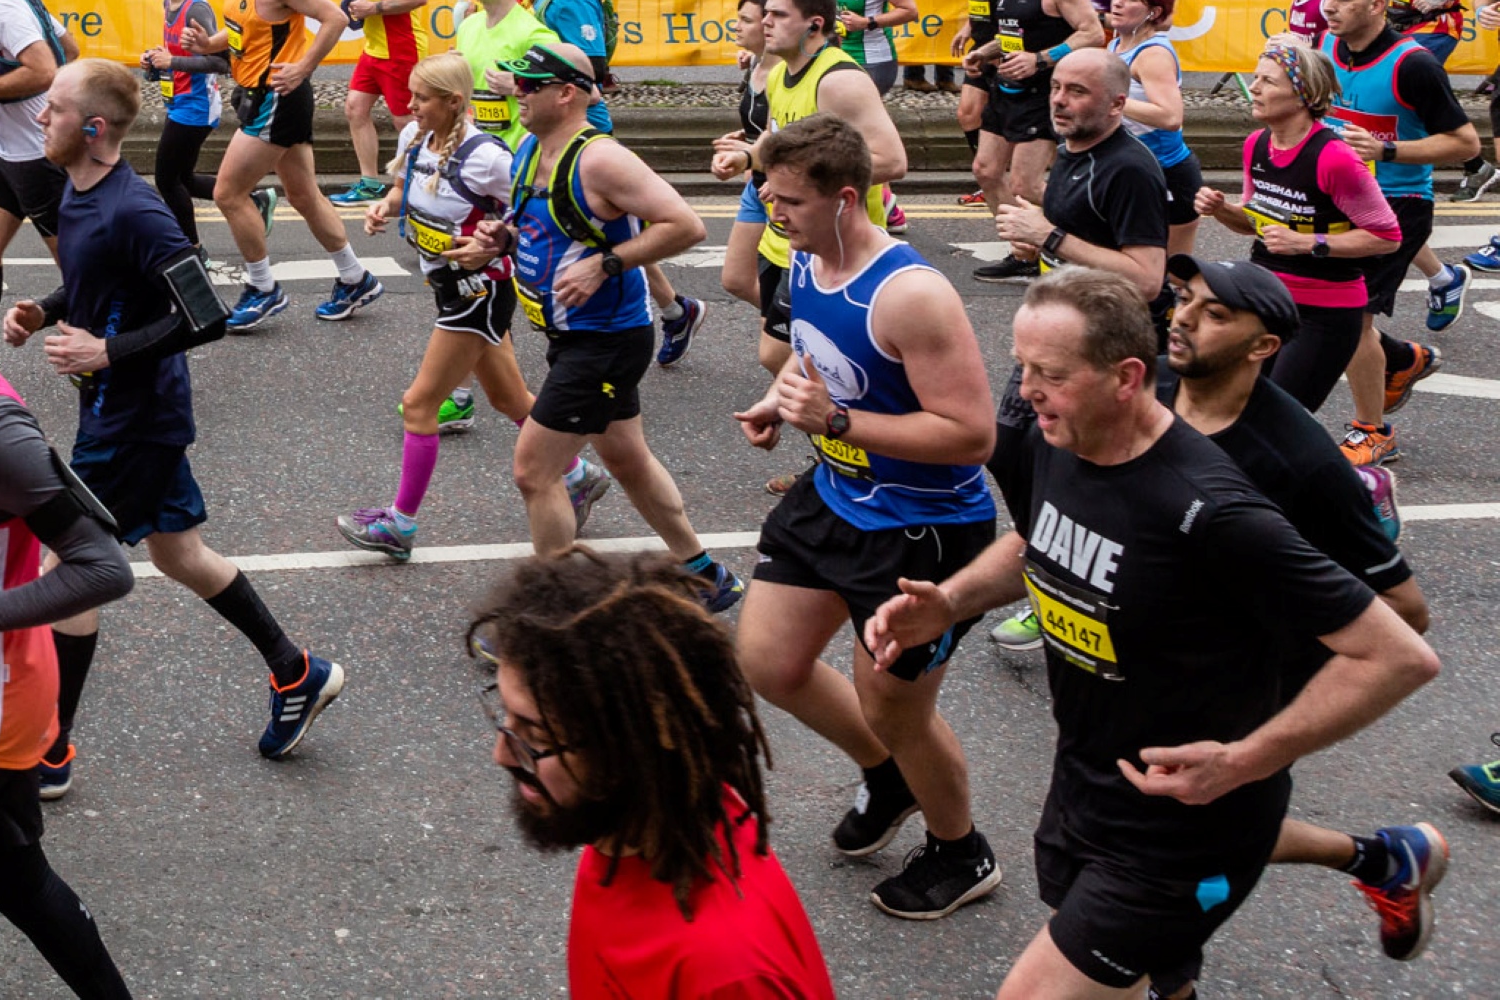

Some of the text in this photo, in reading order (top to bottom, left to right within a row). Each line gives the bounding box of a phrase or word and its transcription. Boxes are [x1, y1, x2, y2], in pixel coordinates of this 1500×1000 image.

[64, 11, 103, 37] re
[891, 14, 943, 39] re
[478, 106, 505, 119] 57181
[1179, 499, 1204, 535] Reebok
[1030, 500, 1125, 594] DAVE
[1046, 609, 1102, 653] 44147
